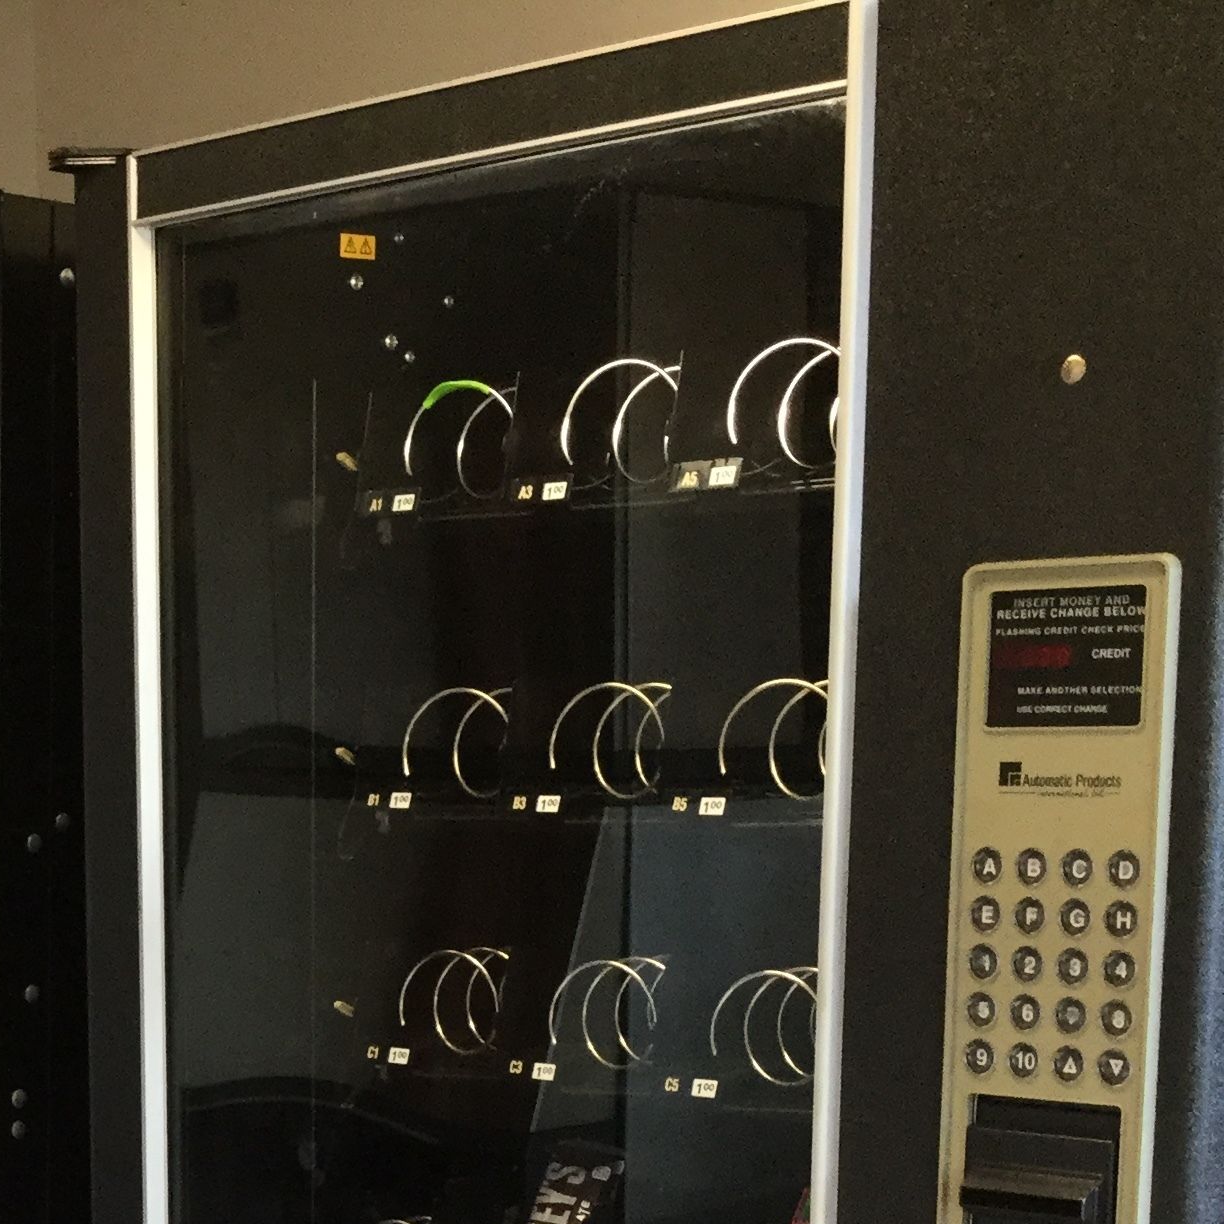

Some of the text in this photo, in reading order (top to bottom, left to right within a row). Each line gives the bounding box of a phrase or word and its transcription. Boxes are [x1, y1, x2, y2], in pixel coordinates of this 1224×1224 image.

[681, 471, 698, 486] A5
[518, 485, 533, 499] A3
[369, 497, 383, 512] A1
[1013, 594, 1130, 607] INSERT MONEY AND
[996, 608, 1047, 619] RECEIVE
[1050, 606, 1100, 618] CHANGE
[1044, 626, 1078, 635] CREDIT
[1081, 625, 1114, 634] CHECK
[1091, 648, 1131, 659] CREDIT
[1017, 686, 1043, 695] MAKE
[1045, 686, 1088, 695] ANOTHER
[1023, 774, 1122, 788] Automatic Products
[367, 793, 380, 807] B1
[512, 796, 527, 810] B3
[672, 797, 687, 811] B5
[982, 858, 997, 875] A
[1027, 858, 1041, 877] B
[1072, 860, 1087, 879] C
[1118, 861, 1134, 880] D
[981, 906, 994, 923] E
[1026, 907, 1038, 926] F
[1069, 909, 1085, 928] G
[1116, 911, 1131, 929] H
[982, 954, 990, 971] 1
[1024, 956, 1036, 974] 2
[1070, 958, 1081, 976] 3
[1115, 961, 1127, 978] 4
[977, 1001, 989, 1018] 5
[1022, 1004, 1033, 1022] 6
[1112, 1009, 1125, 1028] 8
[976, 1049, 987, 1065] 9
[1016, 1052, 1035, 1069] 10
[509, 1060, 523, 1073] C3
[665, 1077, 680, 1092] C5
